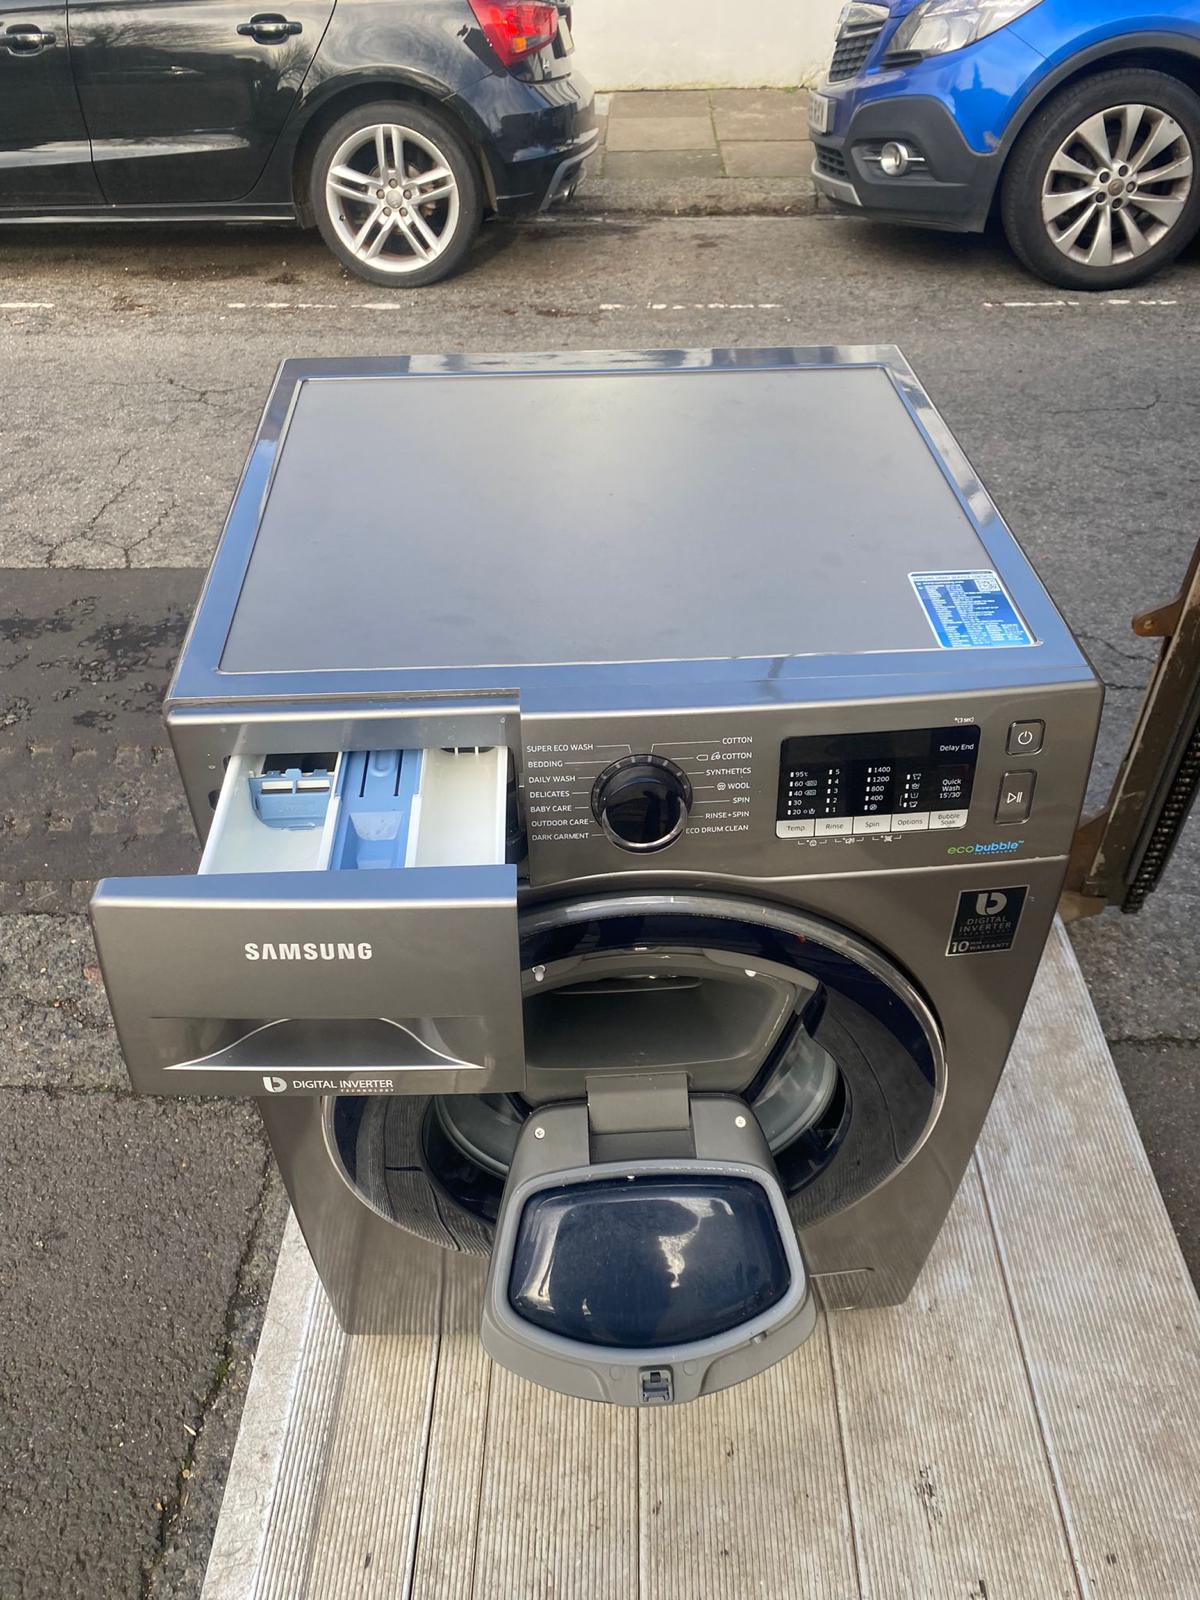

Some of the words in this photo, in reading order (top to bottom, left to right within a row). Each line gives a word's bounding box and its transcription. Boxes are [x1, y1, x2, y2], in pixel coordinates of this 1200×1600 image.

[722, 736, 753, 745] COTTON
[526, 745, 552, 753] SUPER
[554, 744, 569, 752] ECO
[570, 743, 594, 751] WASH
[940, 744, 960, 752] Delay
[961, 743, 975, 751] End
[721, 752, 753, 760] COTTON
[528, 760, 563, 768] BEDDING
[706, 767, 752, 776] SYNTHETICS
[528, 776, 551, 784] DAILY
[942, 778, 962, 786] Quick
[727, 782, 751, 790] WOOL
[942, 785, 961, 793] Wash
[529, 790, 571, 799] DELICATES
[732, 796, 751, 804] SPIN
[530, 805, 551, 813] BABY
[552, 804, 573, 812] CARE
[531, 819, 569, 827] OUTDOOR
[569, 818, 589, 826] CARE
[825, 823, 845, 831] Rinse
[865, 820, 880, 829] Spin
[897, 818, 923, 827] Options
[685, 826, 701, 835] ECO
[701, 825, 724, 833] DRUM
[724, 824, 749, 832] CLEAN
[786, 825, 806, 833] Temp
[553, 832, 590, 840] GARMENT
[967, 916, 1007, 926] DIGITAL
[960, 922, 1012, 933] INVERTER
[244, 942, 373, 960] SAMSUNG
[951, 941, 970, 953] 10
[292, 1080, 337, 1089] DIGITAL
[340, 1079, 394, 1088] INVERTER
